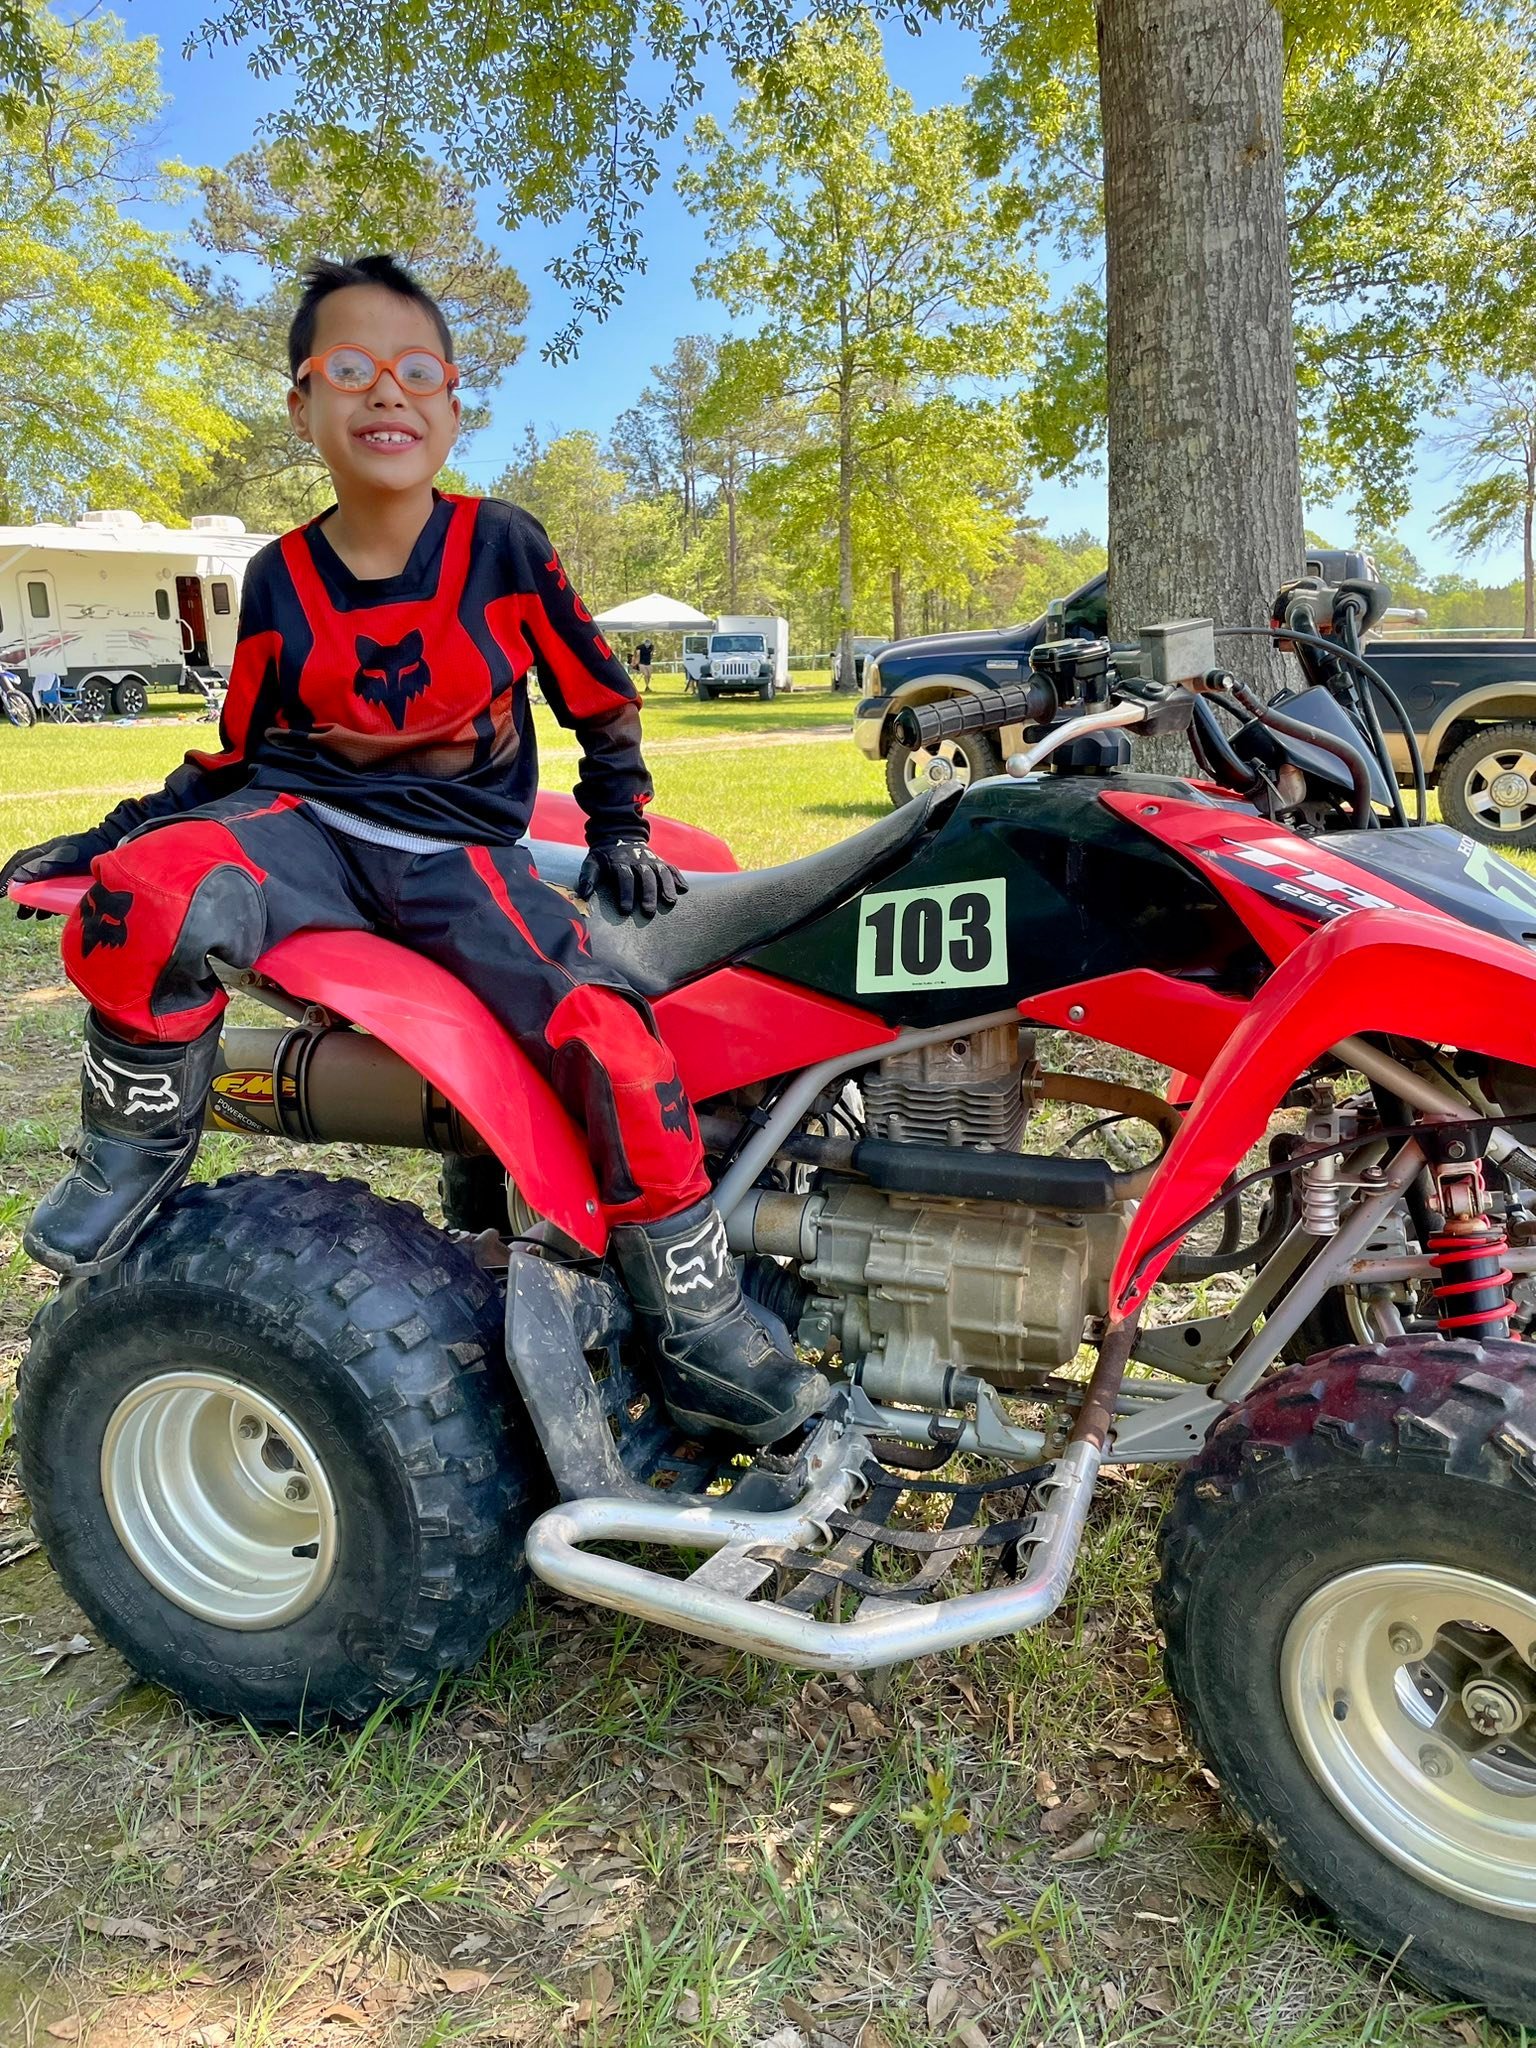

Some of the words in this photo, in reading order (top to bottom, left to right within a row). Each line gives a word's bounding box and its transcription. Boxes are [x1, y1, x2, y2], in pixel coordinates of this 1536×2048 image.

[633, 848, 664, 861] FO
[866, 893, 992, 976] 103
[217, 1098, 262, 1130] POWERCORE
[184, 1328, 351, 1455] DUNLOP
